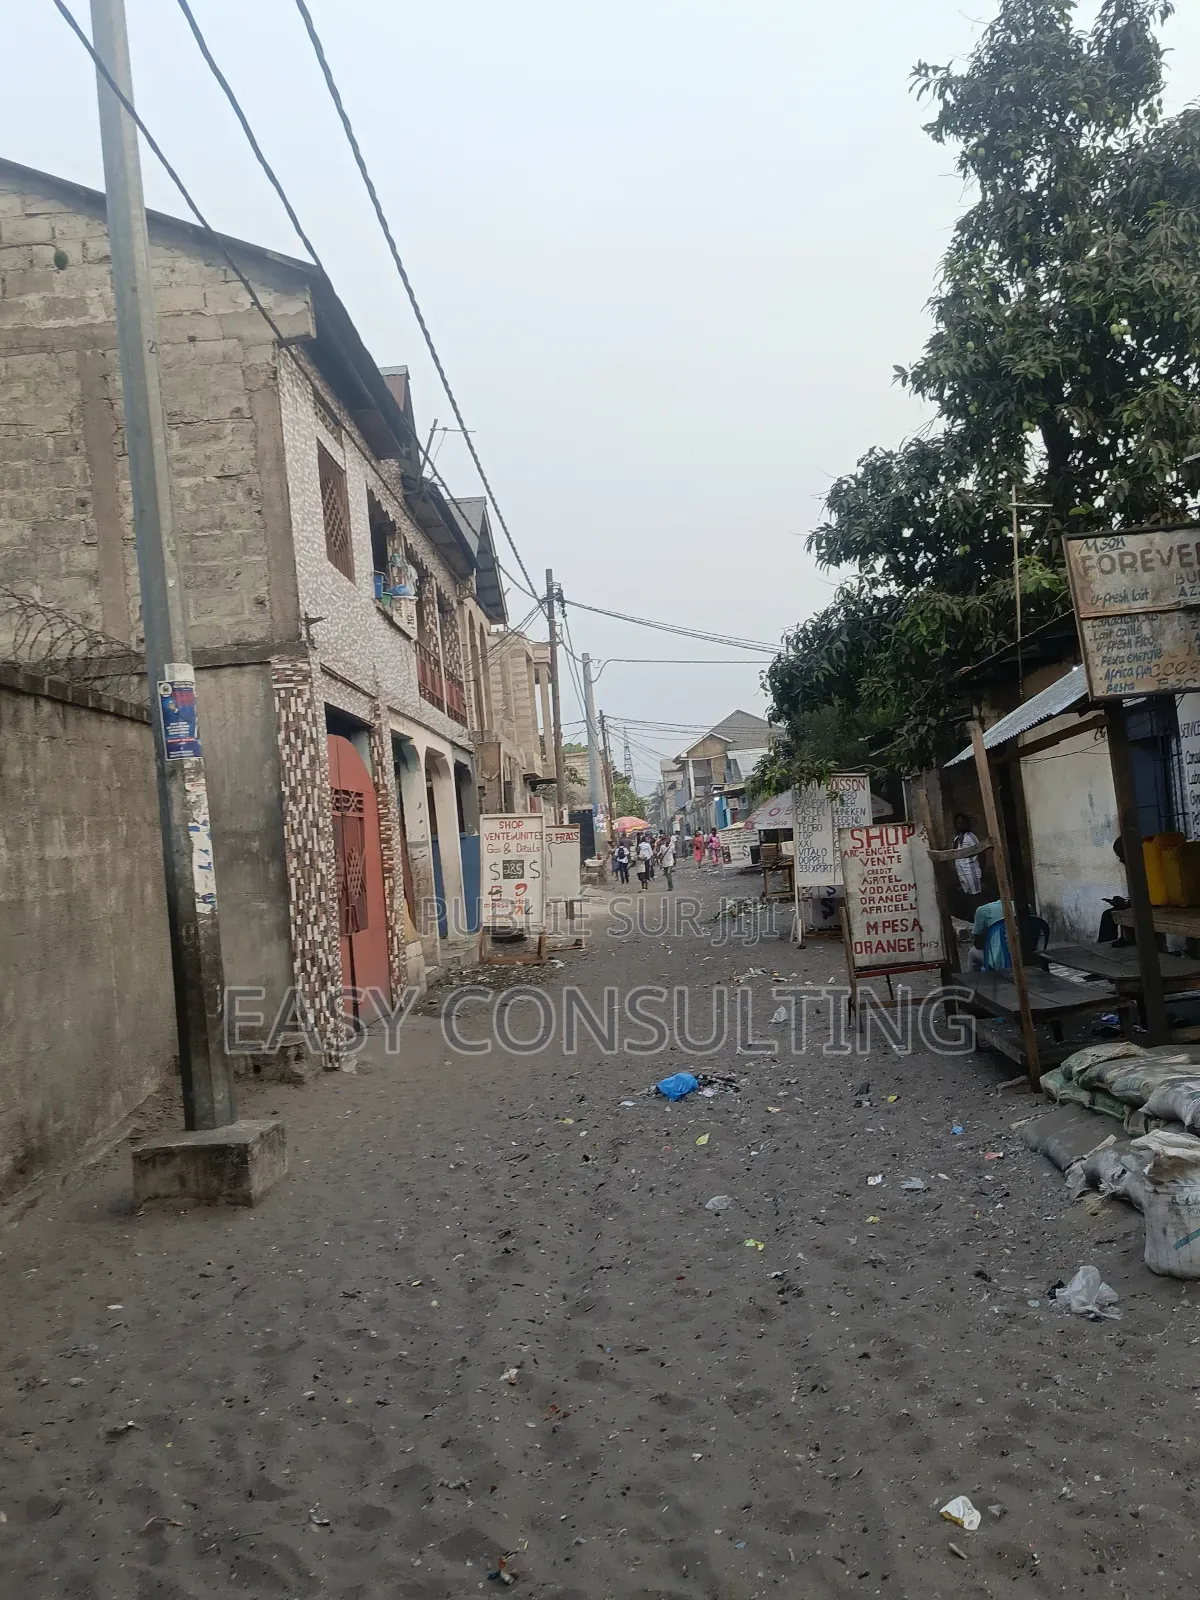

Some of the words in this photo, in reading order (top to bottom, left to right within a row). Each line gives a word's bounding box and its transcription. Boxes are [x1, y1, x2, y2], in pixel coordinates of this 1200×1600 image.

[1080, 543, 1200, 576] FOREVE
[499, 821, 524, 829] SHOP
[555, 832, 579, 841] FRAIS
[797, 832, 813, 840] TOP
[850, 824, 915, 850] SHOP
[859, 855, 902, 867] VENTE
[858, 883, 918, 895] VODACOM
[860, 893, 909, 906] ORANGE
[853, 937, 916, 955] ORANGE
